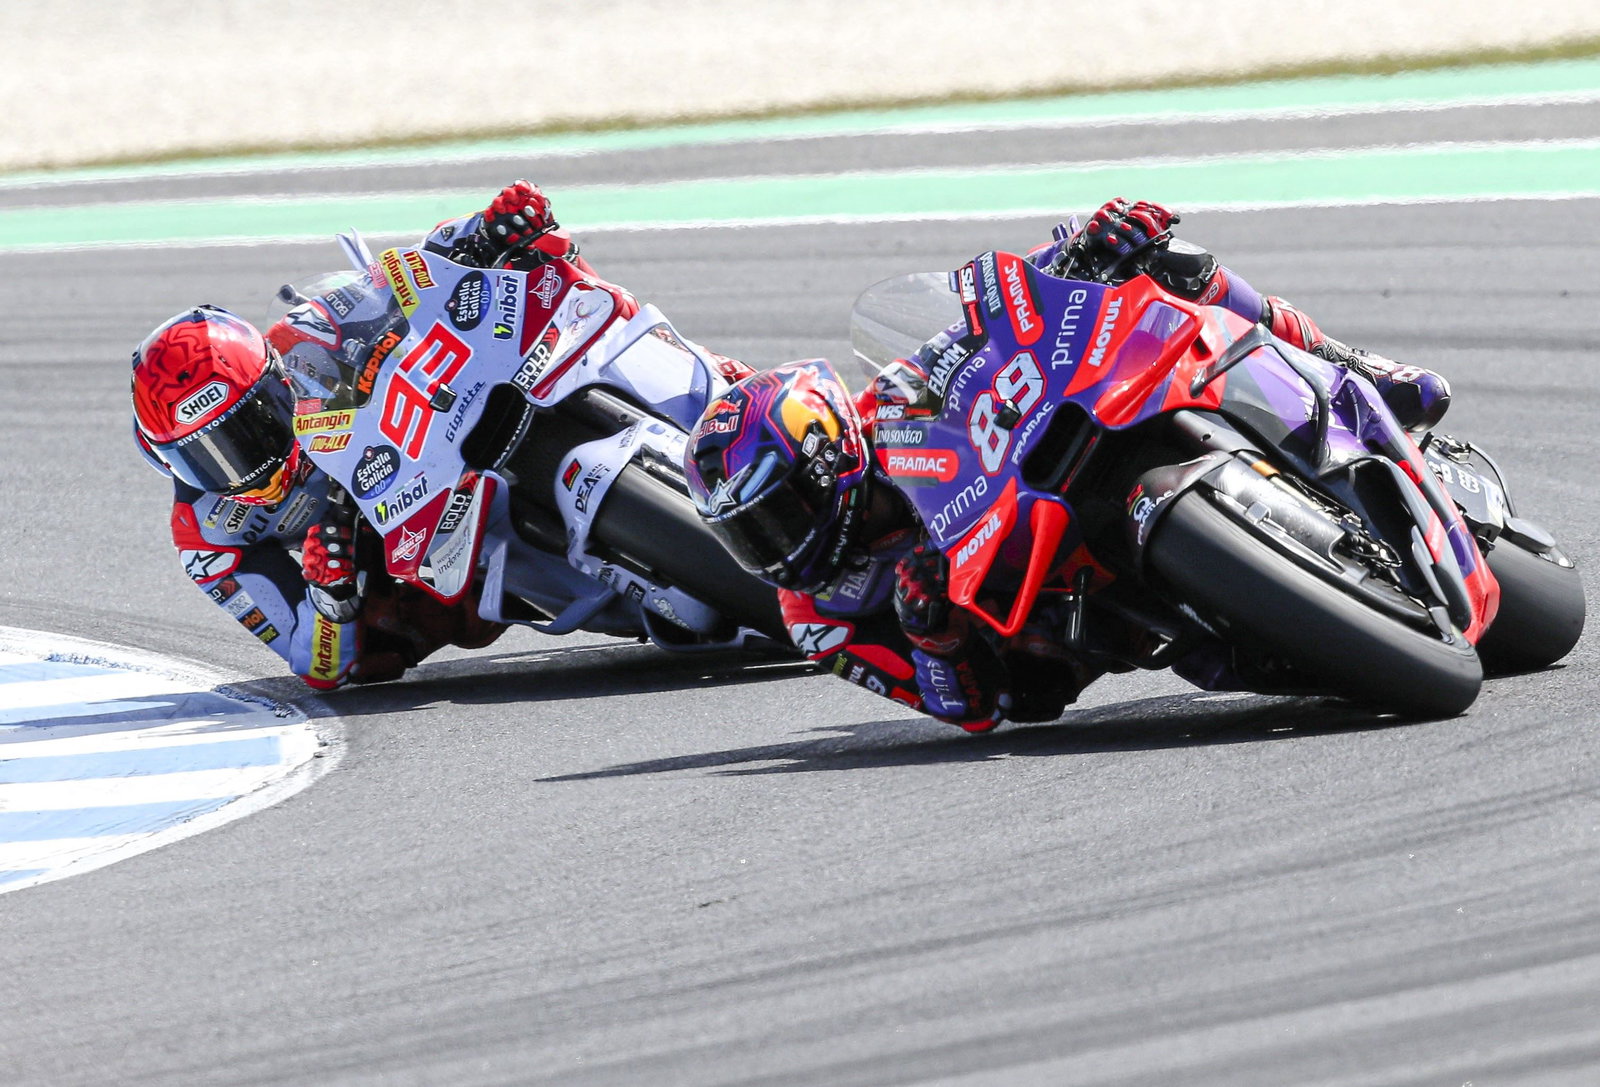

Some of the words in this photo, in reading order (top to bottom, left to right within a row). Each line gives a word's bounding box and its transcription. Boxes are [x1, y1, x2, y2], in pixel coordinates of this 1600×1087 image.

[383, 250, 416, 307] Antangin
[456, 281, 471, 322] Estrella
[468, 280, 481, 319] Galicia
[1004, 260, 1034, 333] PRAMAC
[493, 274, 519, 340] Unibat
[1051, 289, 1087, 370] prima
[1088, 296, 1123, 367] MOTUL
[357, 331, 401, 395] Kapriol
[379, 320, 473, 461] 93
[513, 343, 548, 387] BOLD
[927, 342, 967, 396] FIAMM
[949, 356, 986, 412] prima
[177, 430, 204, 447] GIVES
[205, 415, 227, 431] YOU
[227, 387, 257, 415] WINGS
[181, 386, 222, 419] SHOEI
[296, 412, 351, 431] Antangin
[445, 380, 486, 443] Gigetta
[968, 350, 1046, 475] 89
[1011, 402, 1054, 465] PRAMAC
[239, 456, 277, 484] VERTICAL
[356, 452, 391, 482] Estrella
[361, 464, 394, 491] Galicia
[887, 456, 947, 472] PRAMAC
[227, 503, 250, 530] SHOE
[374, 476, 428, 526] Unibat
[440, 493, 467, 530] BOLD
[930, 476, 988, 542] prima
[956, 513, 1002, 568] MOTUL
